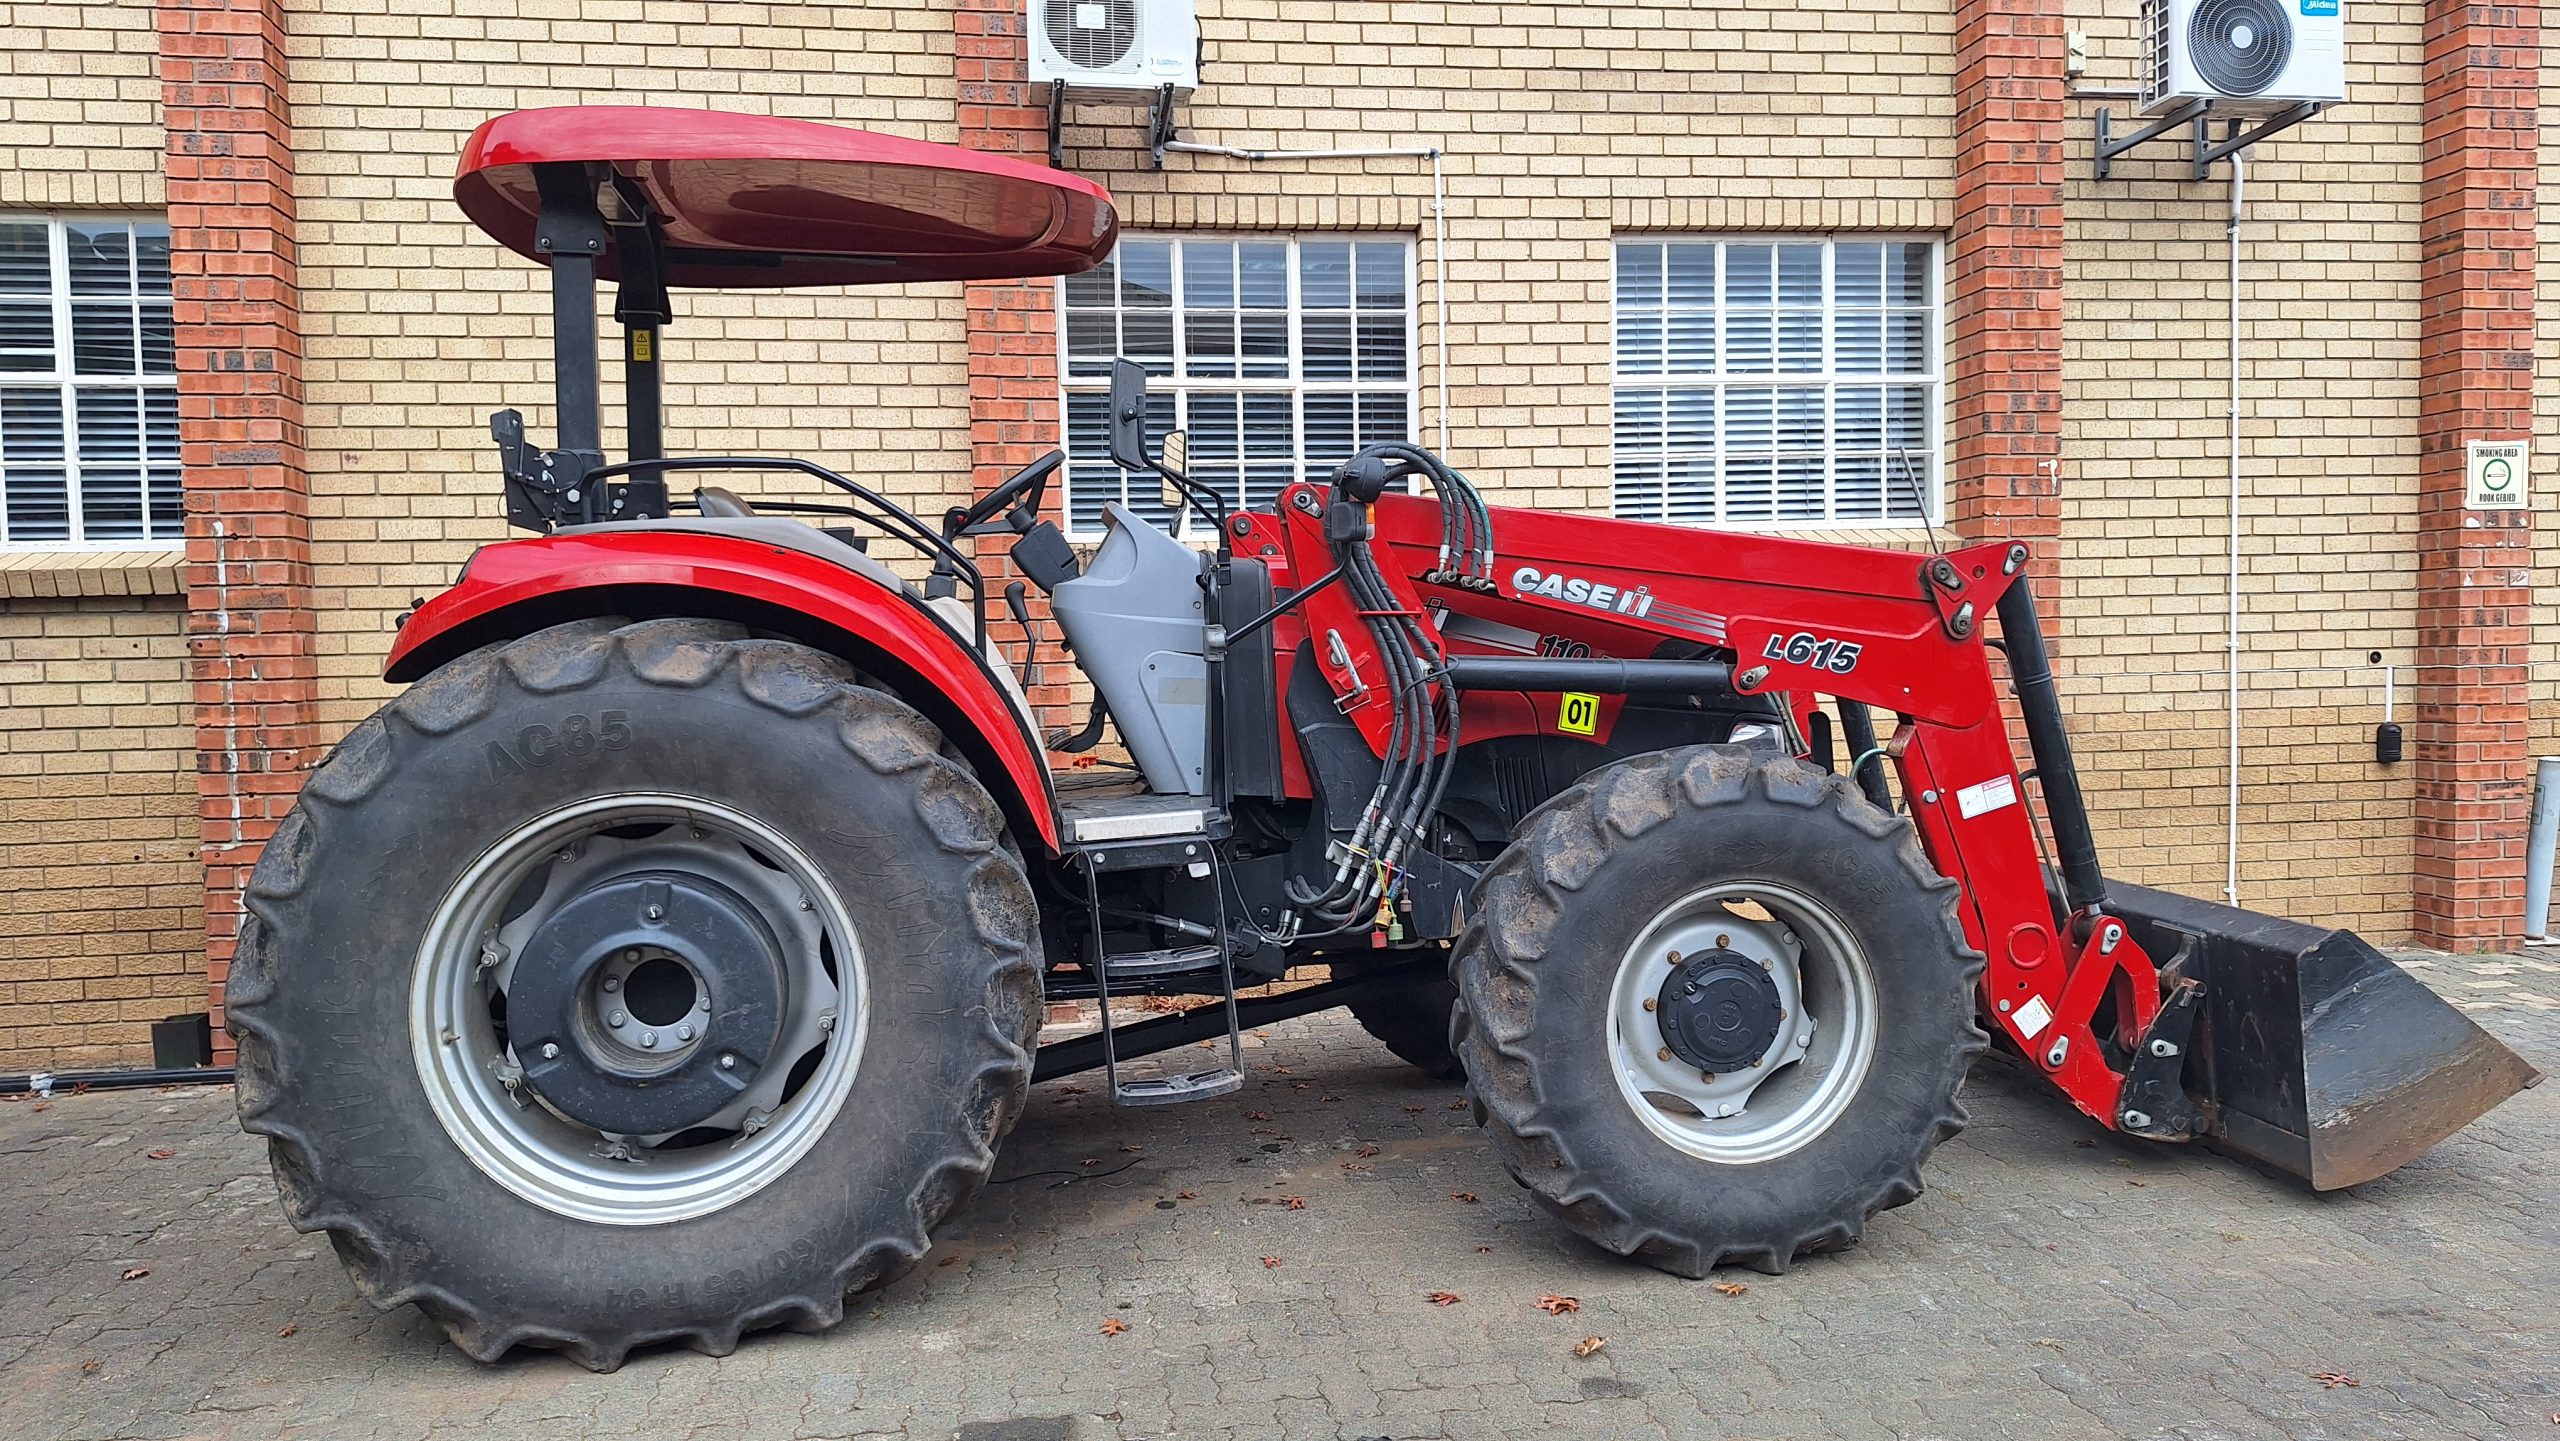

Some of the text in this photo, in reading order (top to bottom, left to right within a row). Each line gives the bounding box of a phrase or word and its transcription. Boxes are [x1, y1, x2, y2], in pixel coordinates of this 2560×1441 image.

[2476, 448, 2518, 457] SMOKING AREA
[2479, 492, 2516, 502] ROOK GEBIED
[1512, 566, 1618, 610] CASE
[1762, 631, 1863, 674] L615
[1567, 698, 1592, 727] 01
[480, 708, 633, 787] AC85
